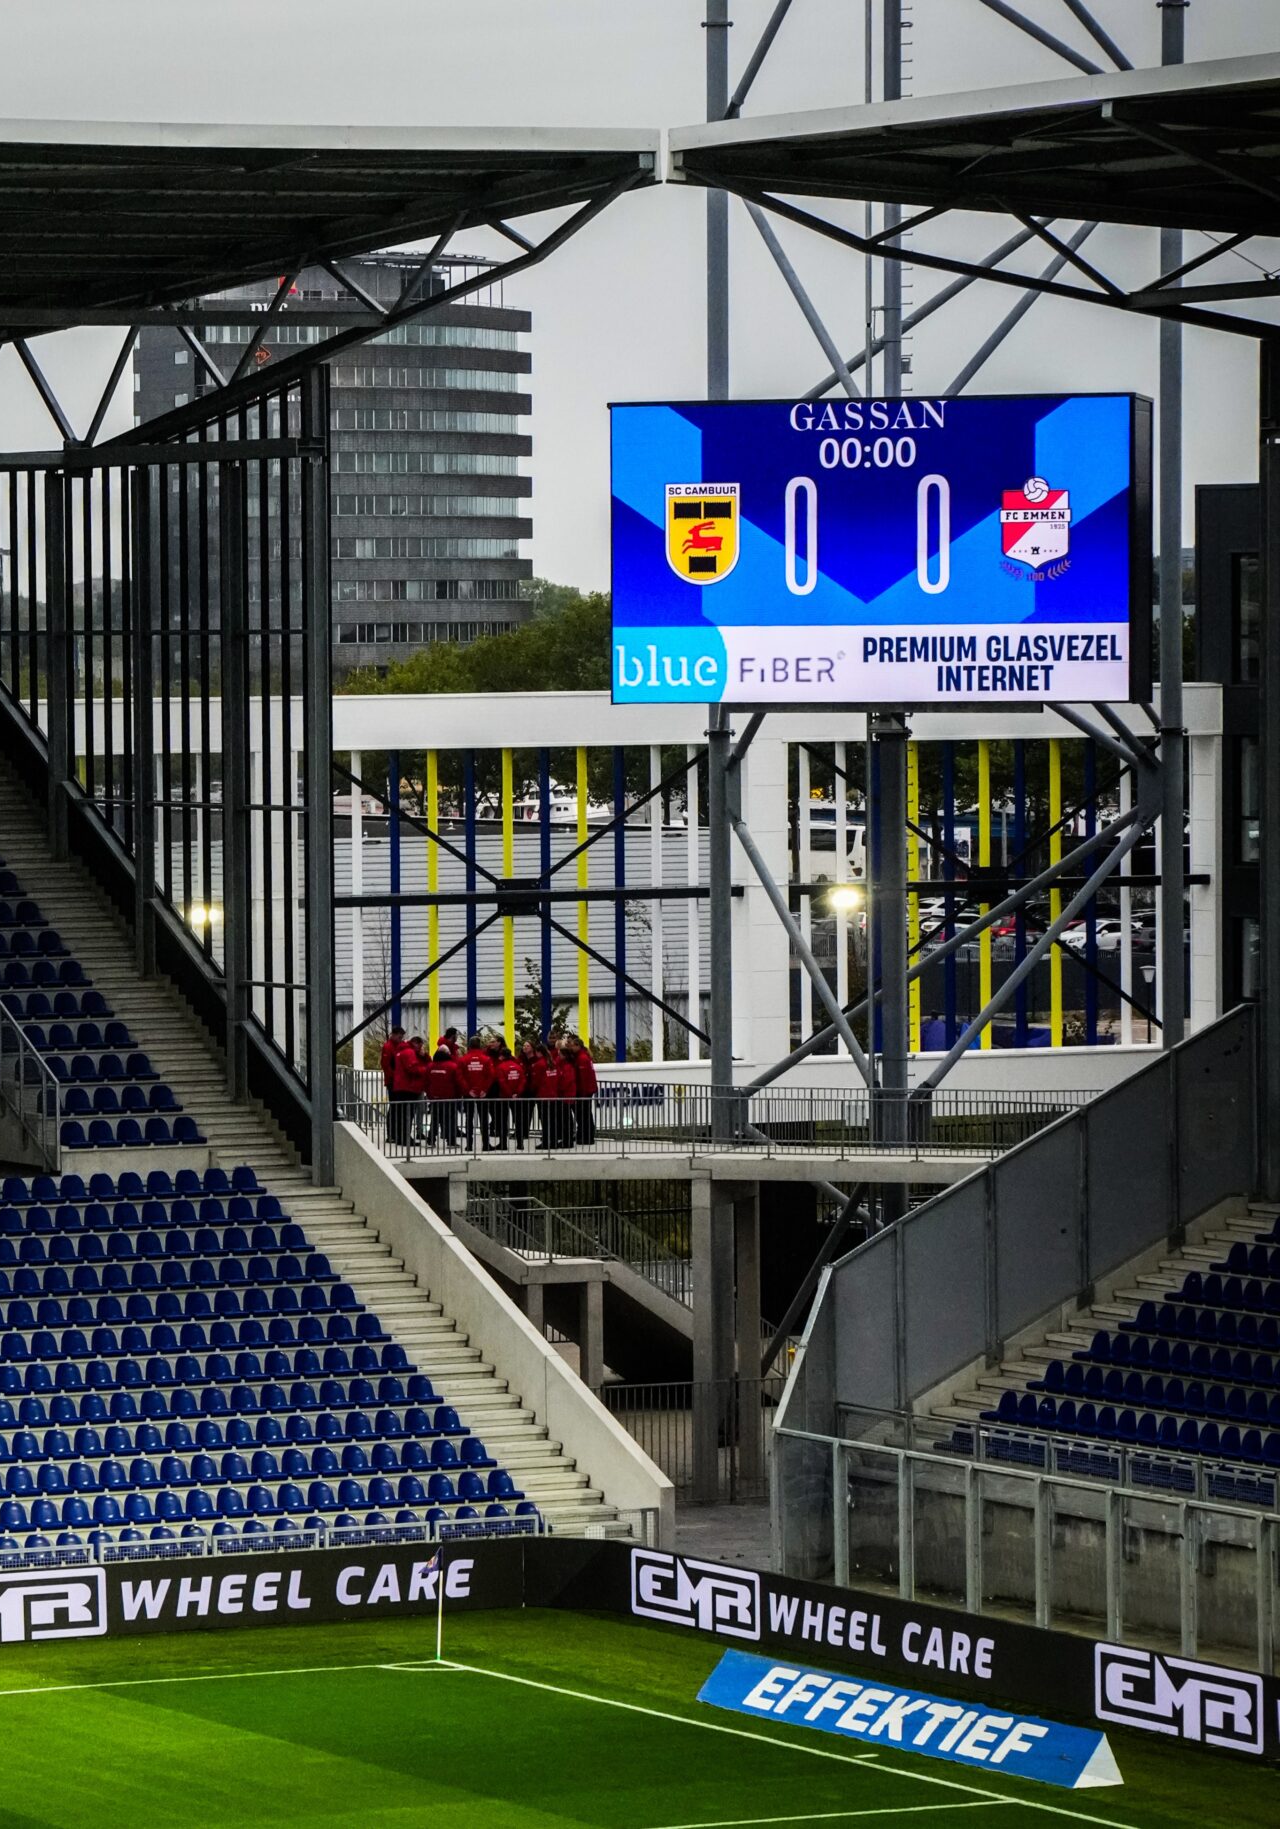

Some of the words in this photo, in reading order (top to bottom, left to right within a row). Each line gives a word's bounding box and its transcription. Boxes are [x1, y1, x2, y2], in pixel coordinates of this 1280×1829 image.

[789, 400, 948, 432] GASSAN
[819, 436, 917, 469] 00:00
[668, 487, 682, 496] SC
[685, 486, 737, 495] CAMBUUR
[785, 476, 818, 596] 0
[917, 473, 950, 595] 0
[1006, 511, 1018, 521] FC
[1023, 511, 1066, 520] EMMEN
[615, 645, 718, 687] blue
[862, 635, 977, 663] PREMIUM
[986, 635, 1122, 662] GLASVEZEL
[937, 665, 1054, 692] INTERNET
[121, 1569, 312, 1622] WHEEL
[335, 1559, 475, 1605] CARE
[637, 1556, 753, 1634] EMR
[768, 1592, 887, 1657] WHEEL
[901, 1621, 995, 1679] CARE
[742, 1667, 1049, 1765] EFFEKTIEF
[1103, 1656, 1255, 1743] EMR
